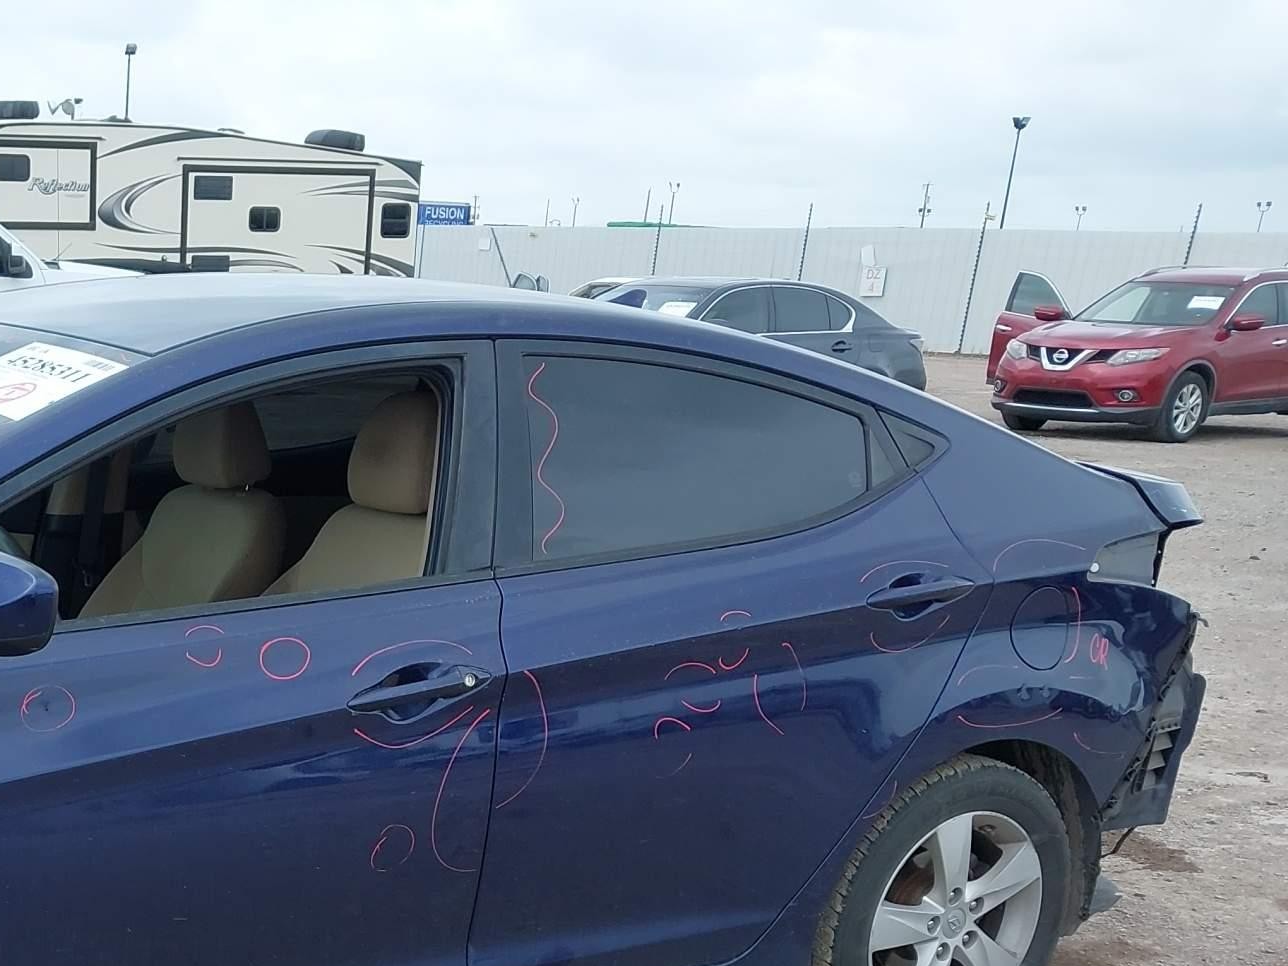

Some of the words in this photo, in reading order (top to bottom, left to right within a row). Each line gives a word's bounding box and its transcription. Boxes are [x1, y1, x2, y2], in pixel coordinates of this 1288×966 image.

[27, 177, 90, 195] Reflection
[425, 207, 465, 219] FUSION
[8, 356, 92, 382] 45285311
